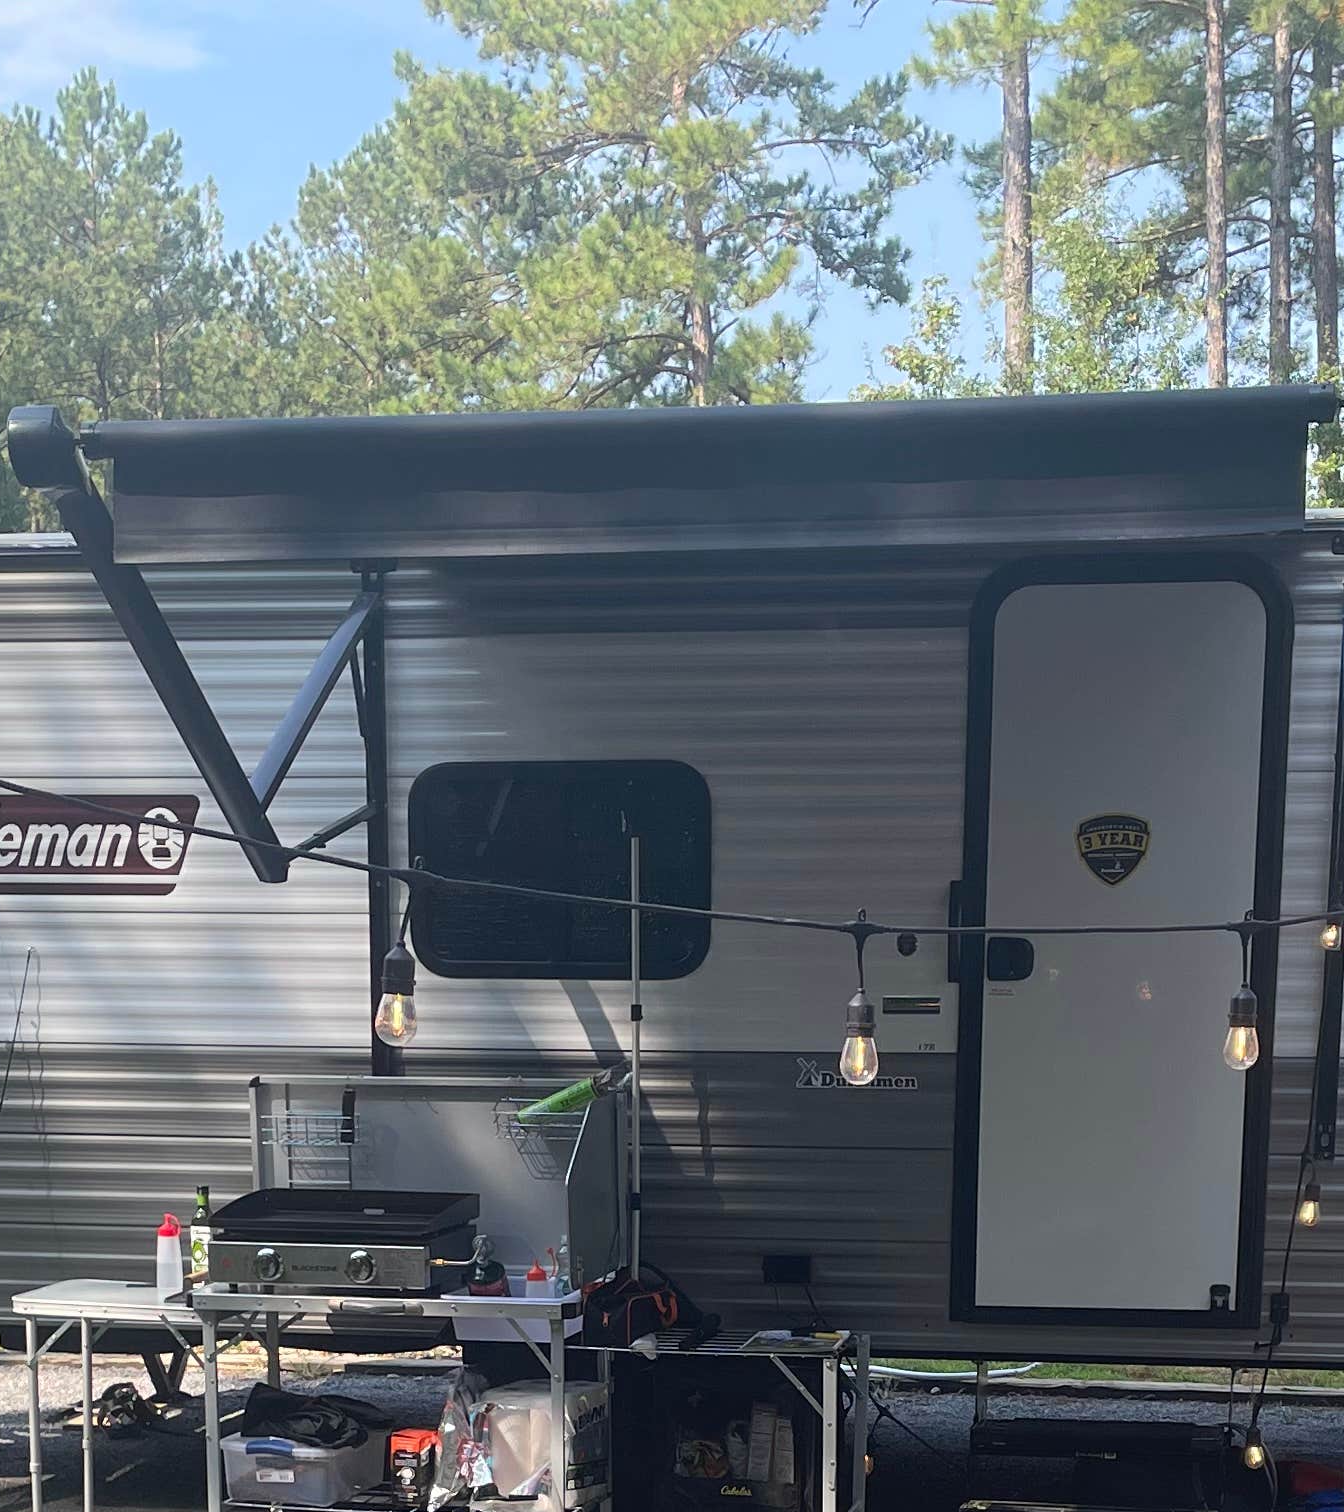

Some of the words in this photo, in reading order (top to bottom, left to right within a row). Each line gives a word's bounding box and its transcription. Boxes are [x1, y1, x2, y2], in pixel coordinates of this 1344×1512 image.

[1082, 836, 1093, 849] 3
[1097, 832, 1145, 848] YEAR
[820, 1071, 917, 1088] Dumen
